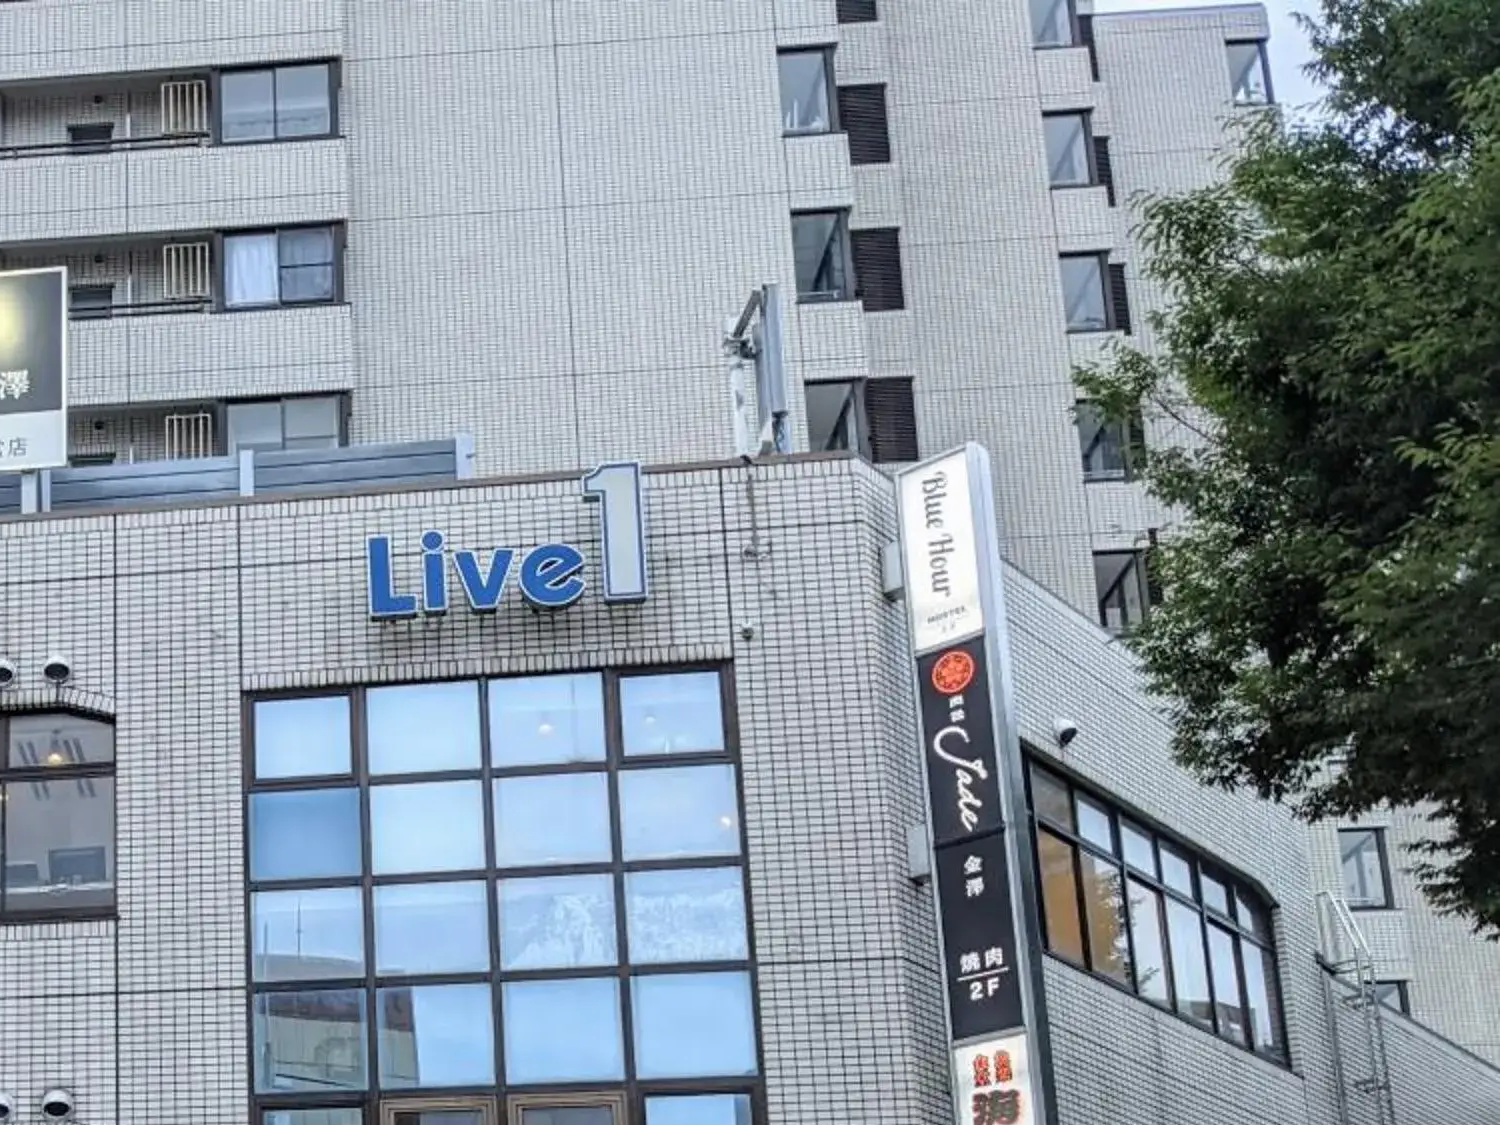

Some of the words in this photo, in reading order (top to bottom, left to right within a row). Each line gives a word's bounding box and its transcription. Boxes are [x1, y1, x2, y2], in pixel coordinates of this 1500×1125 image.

[920, 470, 949, 530] Blue
[927, 532, 956, 599] Hour
[959, 946, 1004, 973] 焼肉
[969, 975, 1000, 1001] 2F
